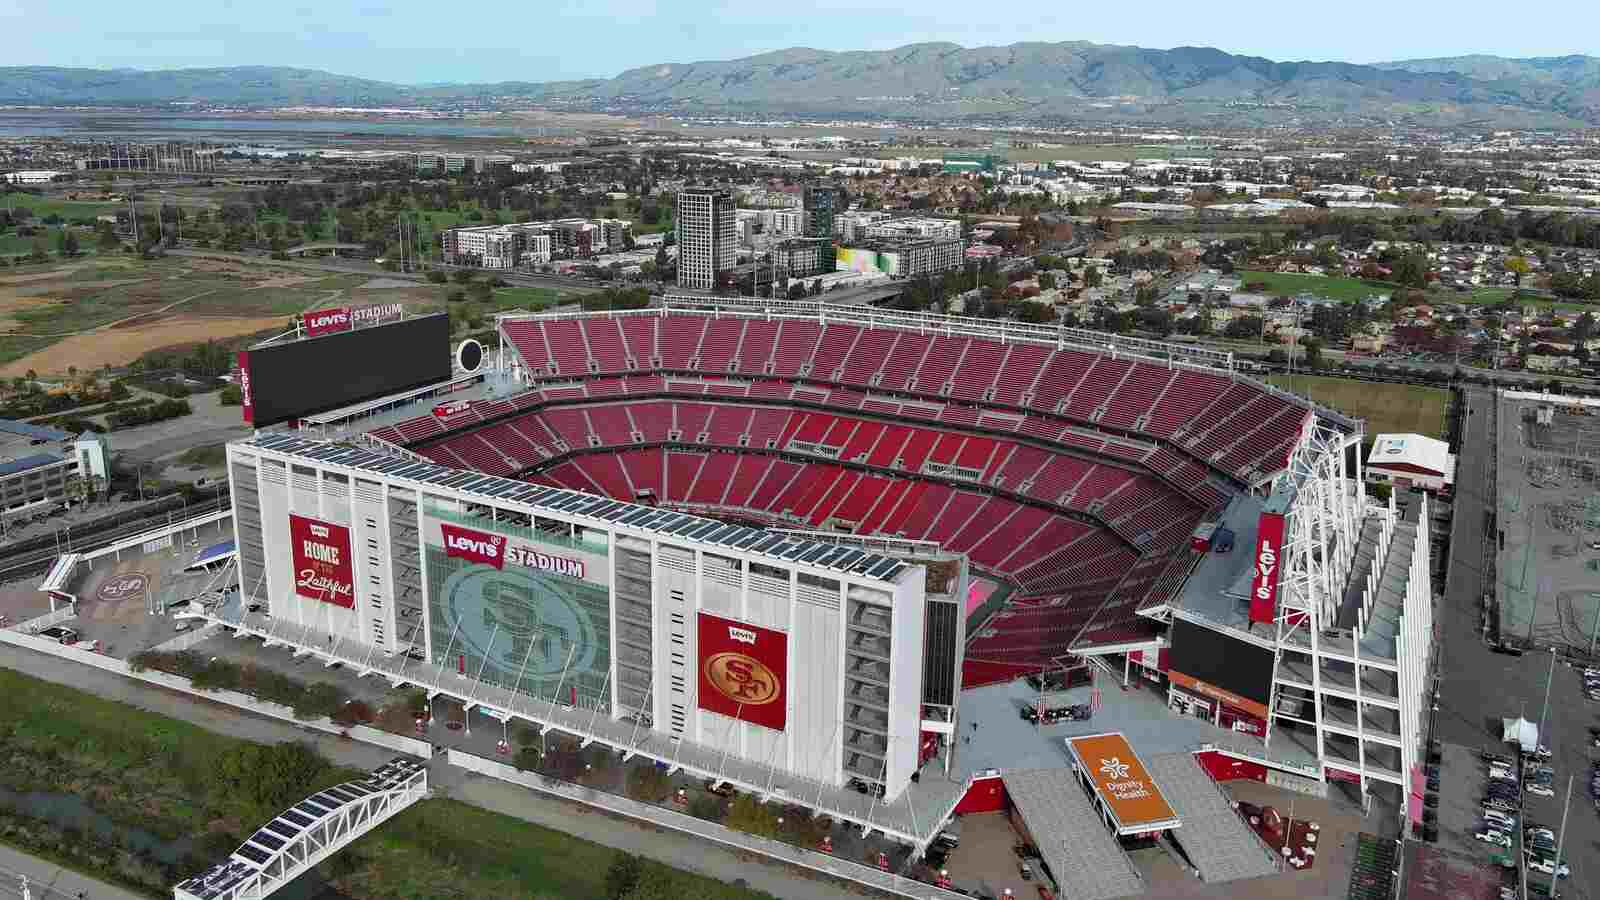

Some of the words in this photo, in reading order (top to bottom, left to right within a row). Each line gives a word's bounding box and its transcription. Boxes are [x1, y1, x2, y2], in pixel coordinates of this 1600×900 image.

[354, 303, 400, 320] STADIUM
[303, 540, 339, 565] HOME
[508, 548, 585, 578] STADIUM
[297, 569, 352, 599] Faithful
